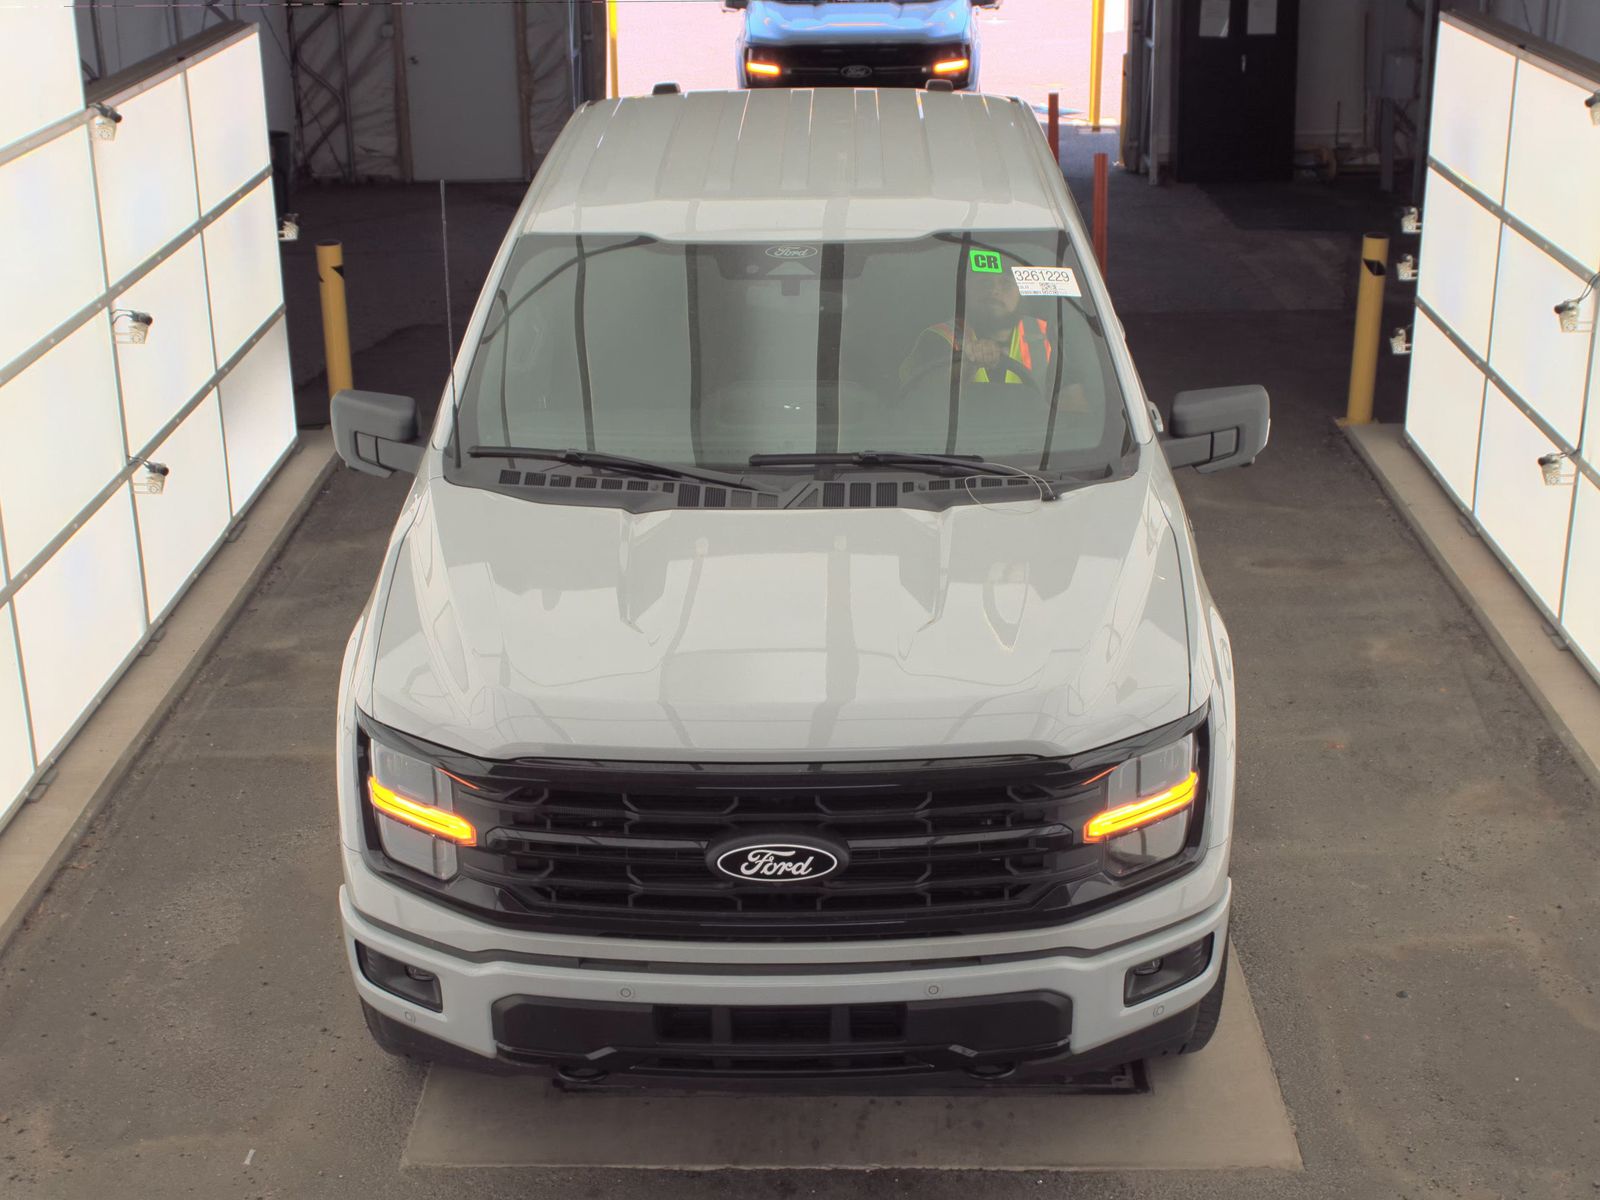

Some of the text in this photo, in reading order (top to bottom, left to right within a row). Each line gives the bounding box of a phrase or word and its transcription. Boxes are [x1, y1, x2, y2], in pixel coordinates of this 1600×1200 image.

[774, 246, 809, 256] Ford
[973, 254, 999, 269] CR
[1014, 270, 1070, 282] 3261229
[740, 849, 814, 875] Ford
